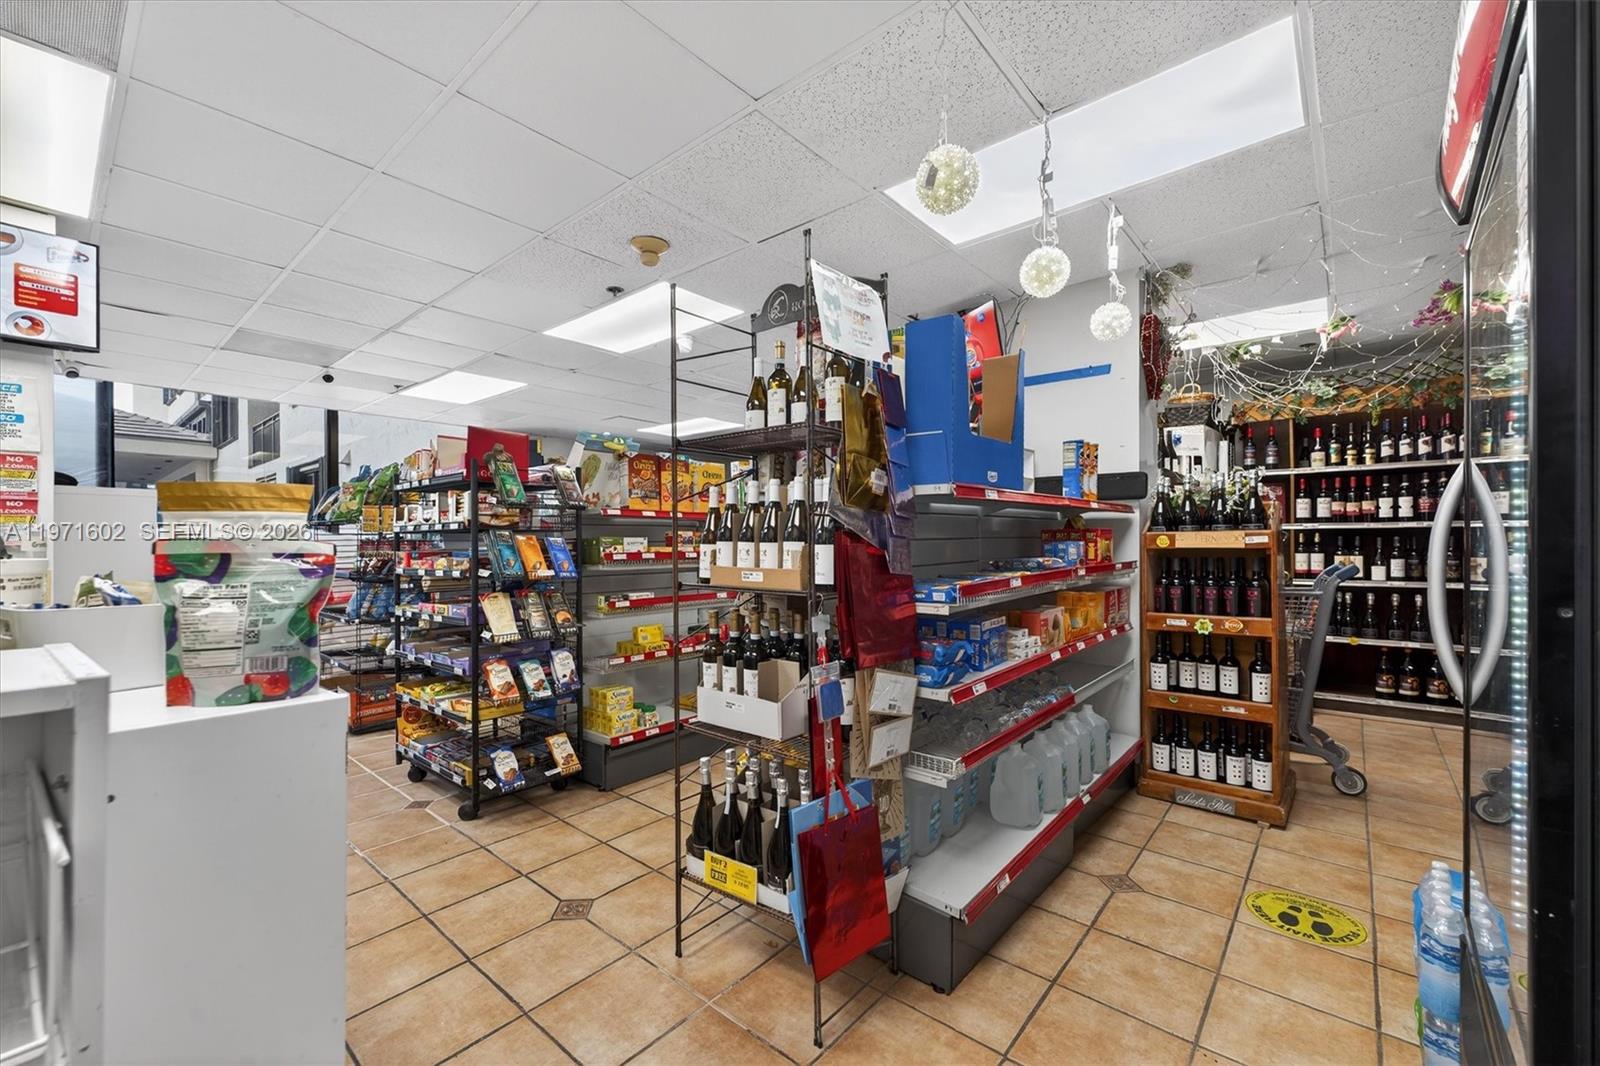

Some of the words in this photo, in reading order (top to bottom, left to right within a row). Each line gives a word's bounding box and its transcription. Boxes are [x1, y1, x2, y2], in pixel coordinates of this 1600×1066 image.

[1251, 903, 1277, 924] HERE
[1276, 923, 1317, 940] WAIT
[1321, 930, 1361, 944] PLEASE
